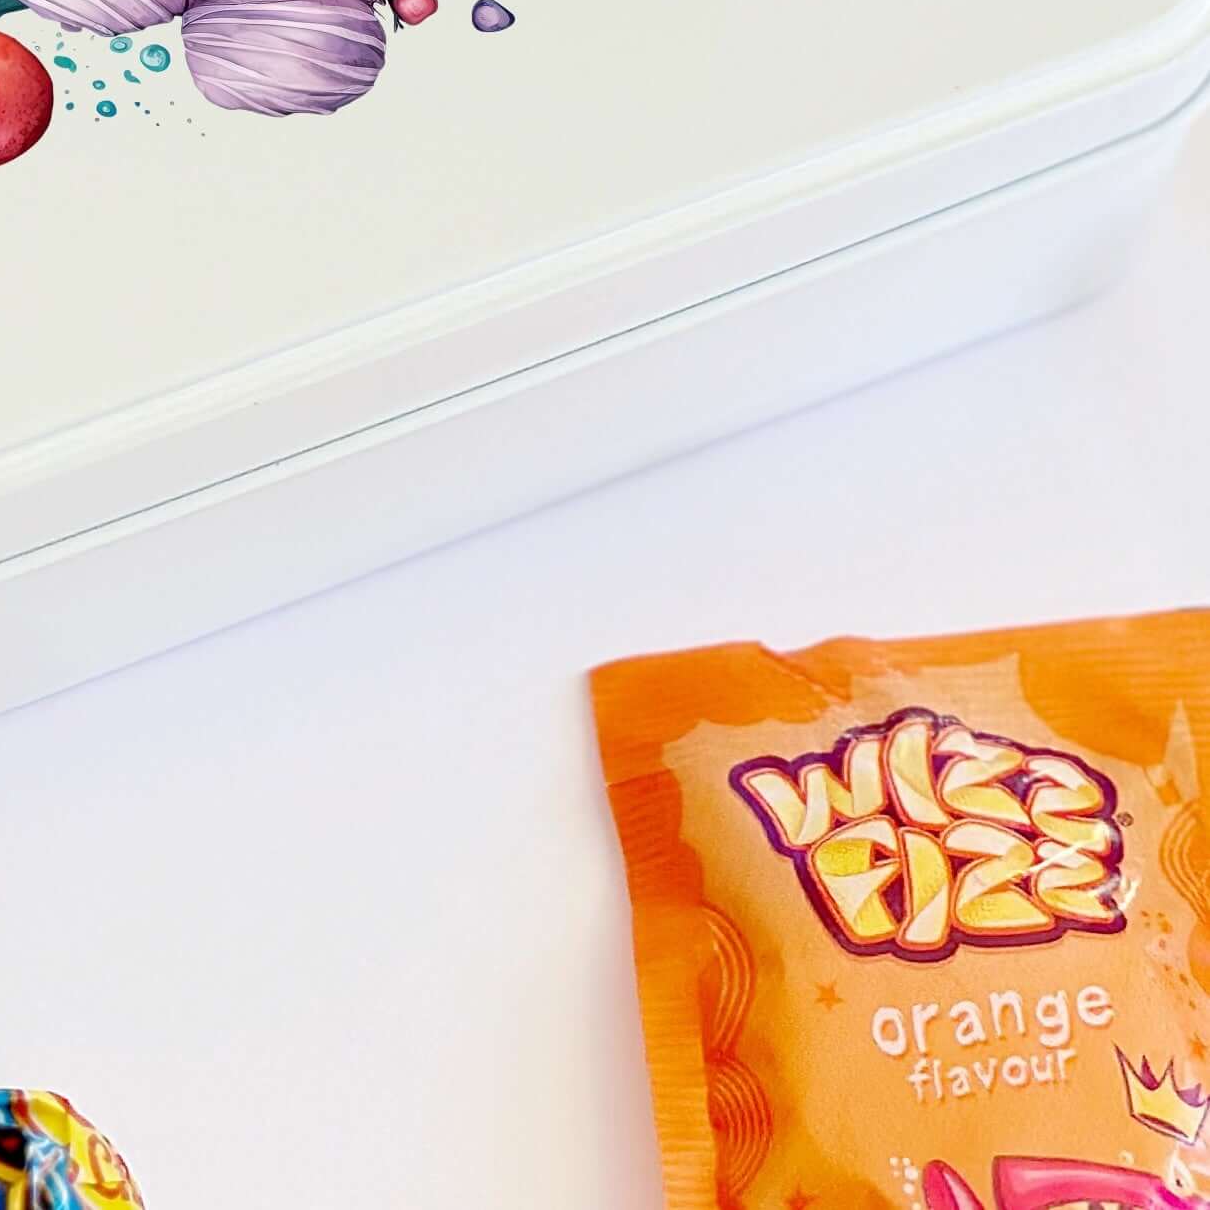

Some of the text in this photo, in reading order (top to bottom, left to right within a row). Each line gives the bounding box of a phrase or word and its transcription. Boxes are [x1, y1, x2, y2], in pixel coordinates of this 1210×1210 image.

[738, 715, 1116, 856] WIZZ
[802, 812, 1122, 951] FIZZ
[871, 985, 1116, 1057] orange
[907, 1048, 1078, 1103] flavour
